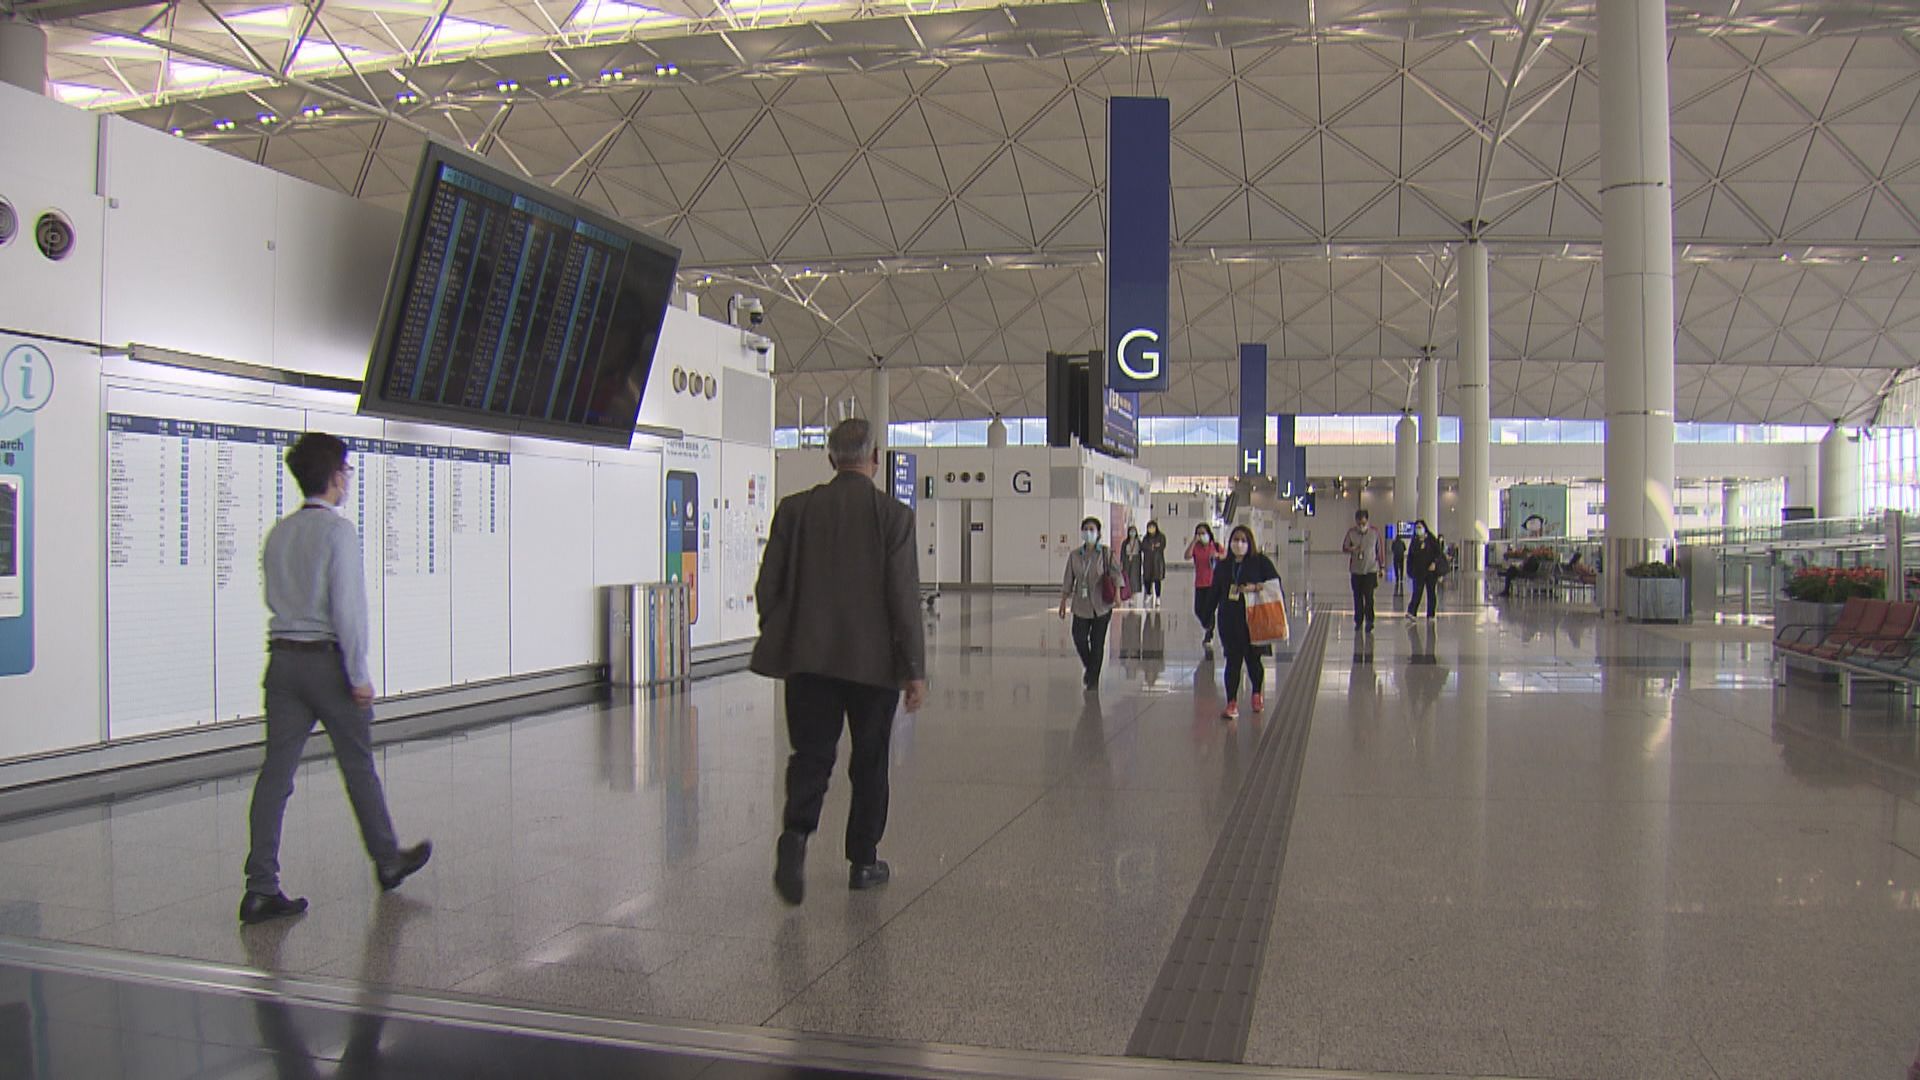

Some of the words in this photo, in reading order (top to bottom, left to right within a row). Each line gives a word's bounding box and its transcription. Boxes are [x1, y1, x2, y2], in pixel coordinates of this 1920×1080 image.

[1117, 328, 1160, 380] G
[19, 353, 35, 400] i
[0, 438, 24, 451] arch
[1244, 449, 1262, 474] H
[1012, 470, 1032, 494] G
[1282, 481, 1291, 498] J
[1168, 503, 1179, 516] H
[1295, 495, 1305, 510] K
[1306, 503, 1314, 516] L
